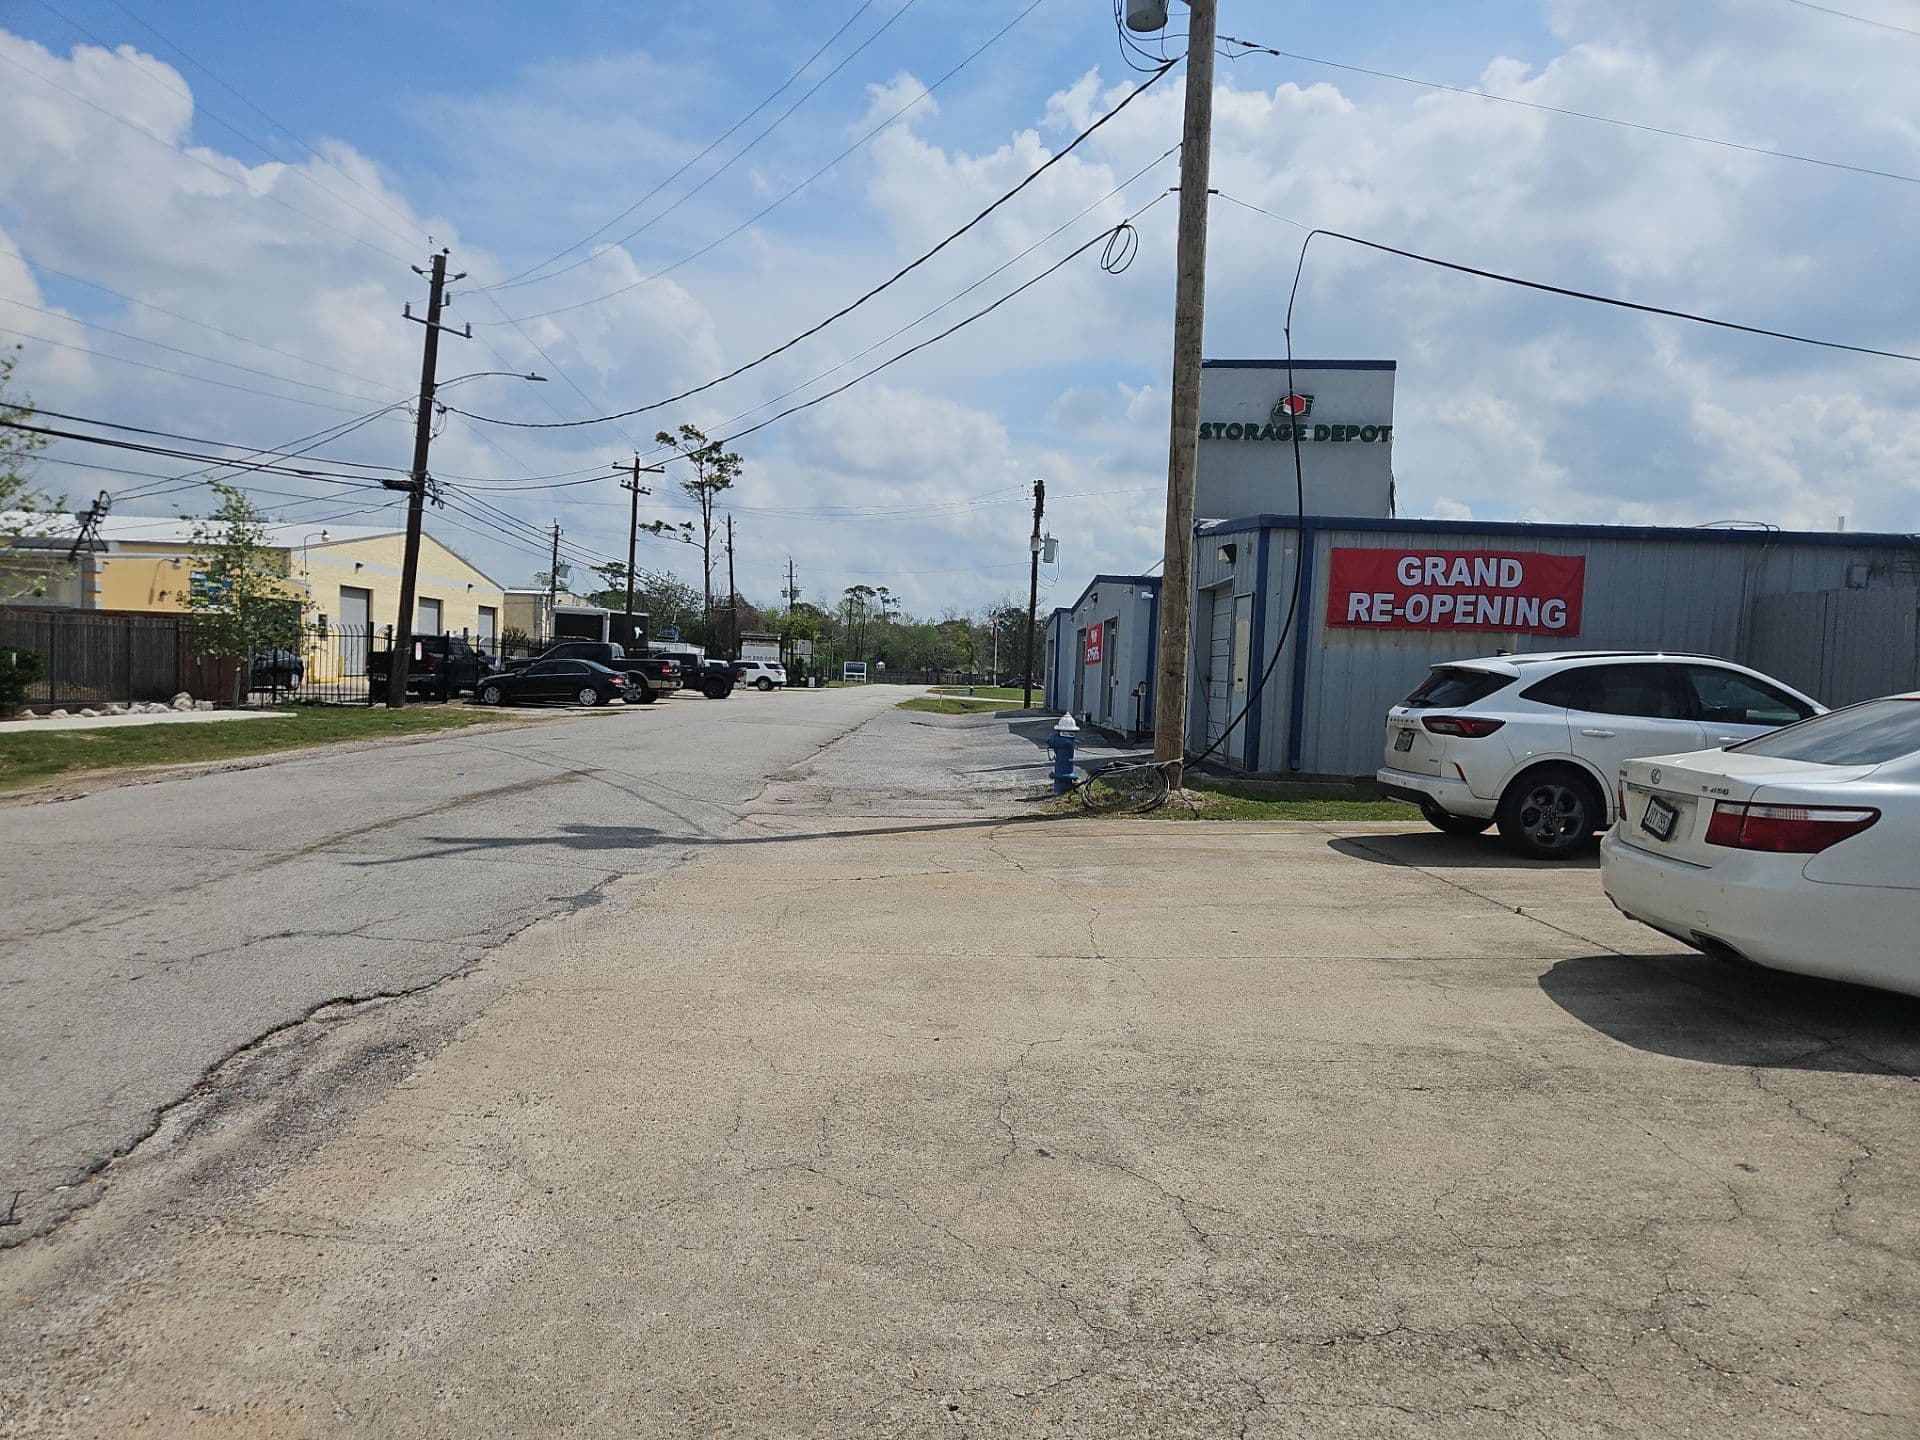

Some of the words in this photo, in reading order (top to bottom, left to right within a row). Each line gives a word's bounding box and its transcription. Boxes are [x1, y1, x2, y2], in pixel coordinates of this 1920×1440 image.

[1199, 422, 1308, 442] STORAGE
[1313, 423, 1393, 443] DEPOT
[1396, 556, 1524, 589] GRAND
[1346, 592, 1567, 630] RE-OPENING
